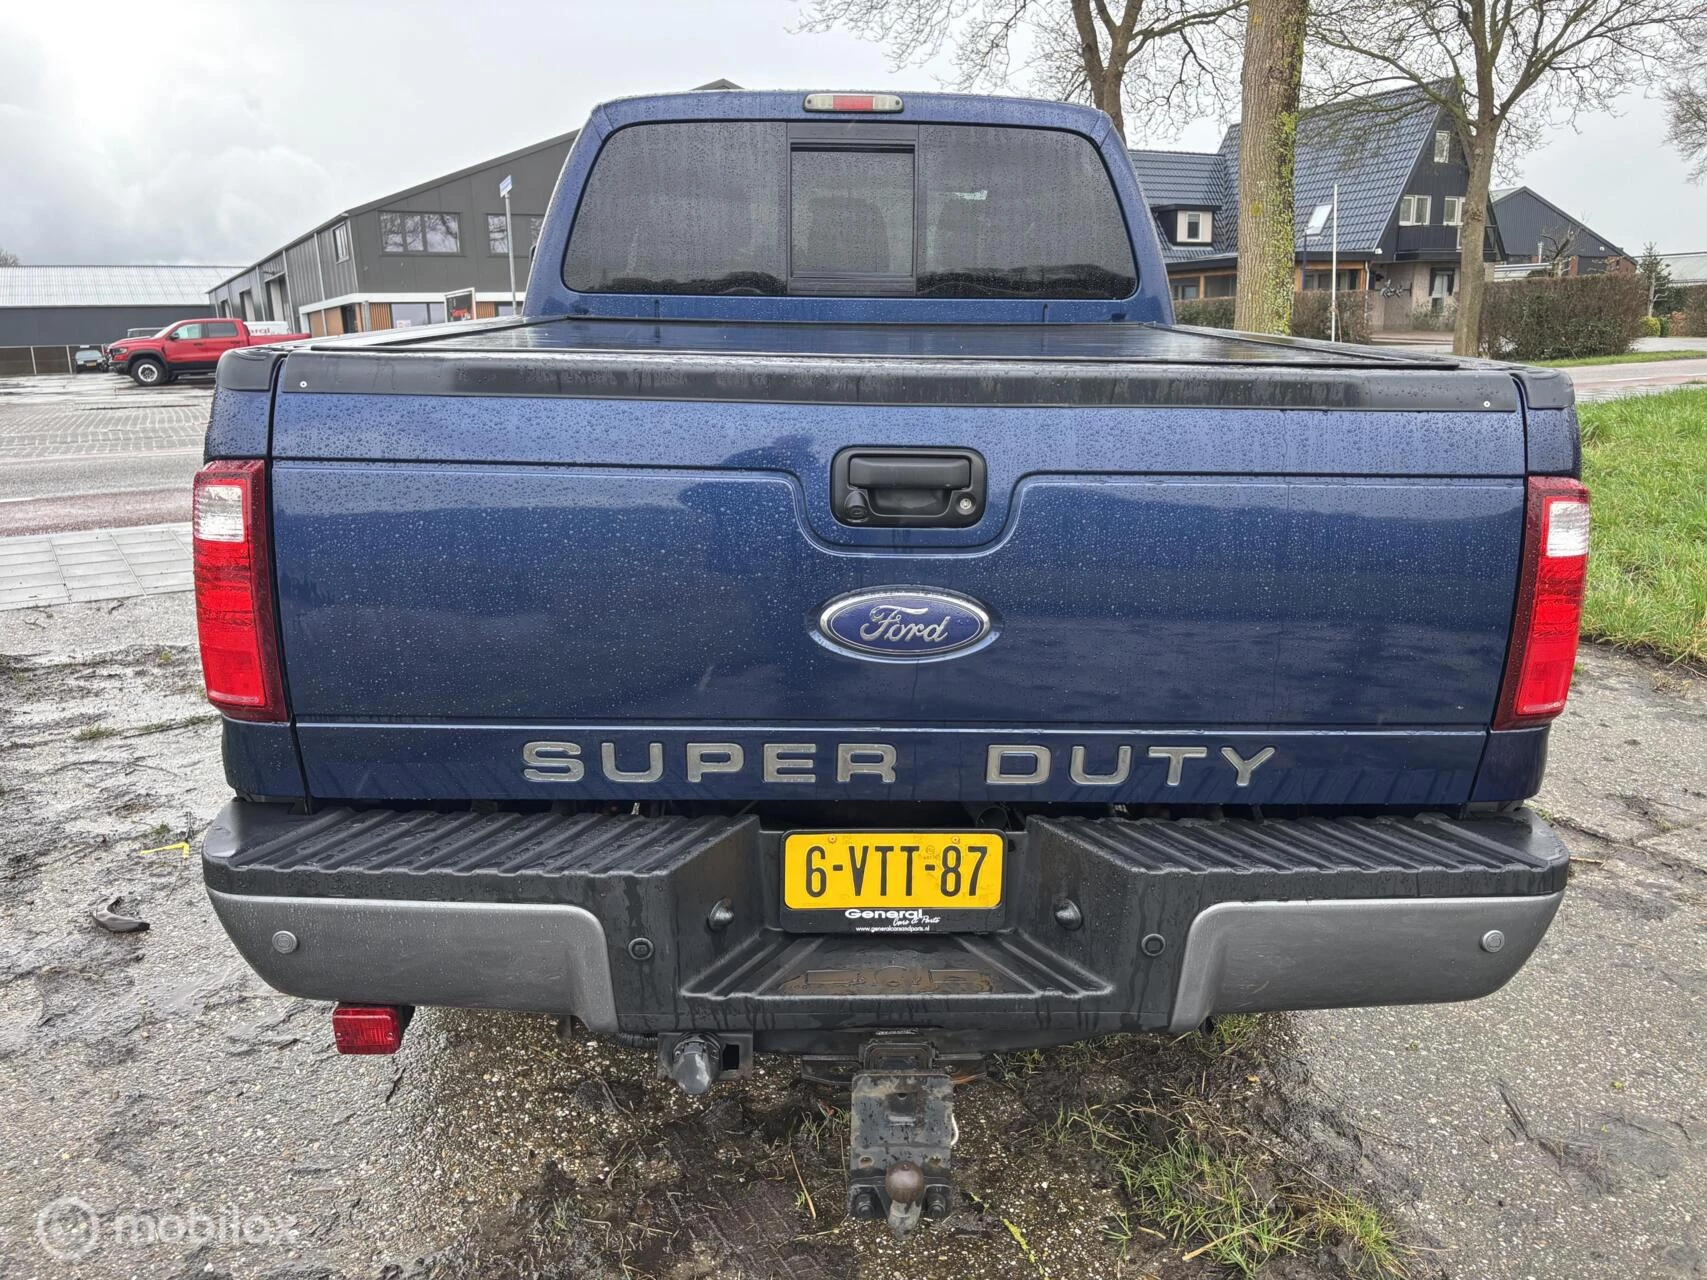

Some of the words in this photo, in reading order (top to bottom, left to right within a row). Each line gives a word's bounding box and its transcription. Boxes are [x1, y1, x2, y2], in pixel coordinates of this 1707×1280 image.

[860, 605, 951, 642] Ford
[523, 741, 898, 783] SUPER
[986, 744, 1276, 786] DUTY
[805, 845, 989, 898] 6-VTT-87
[844, 908, 923, 919] General
[855, 925, 930, 933] www.generalcarsandparts.nl
